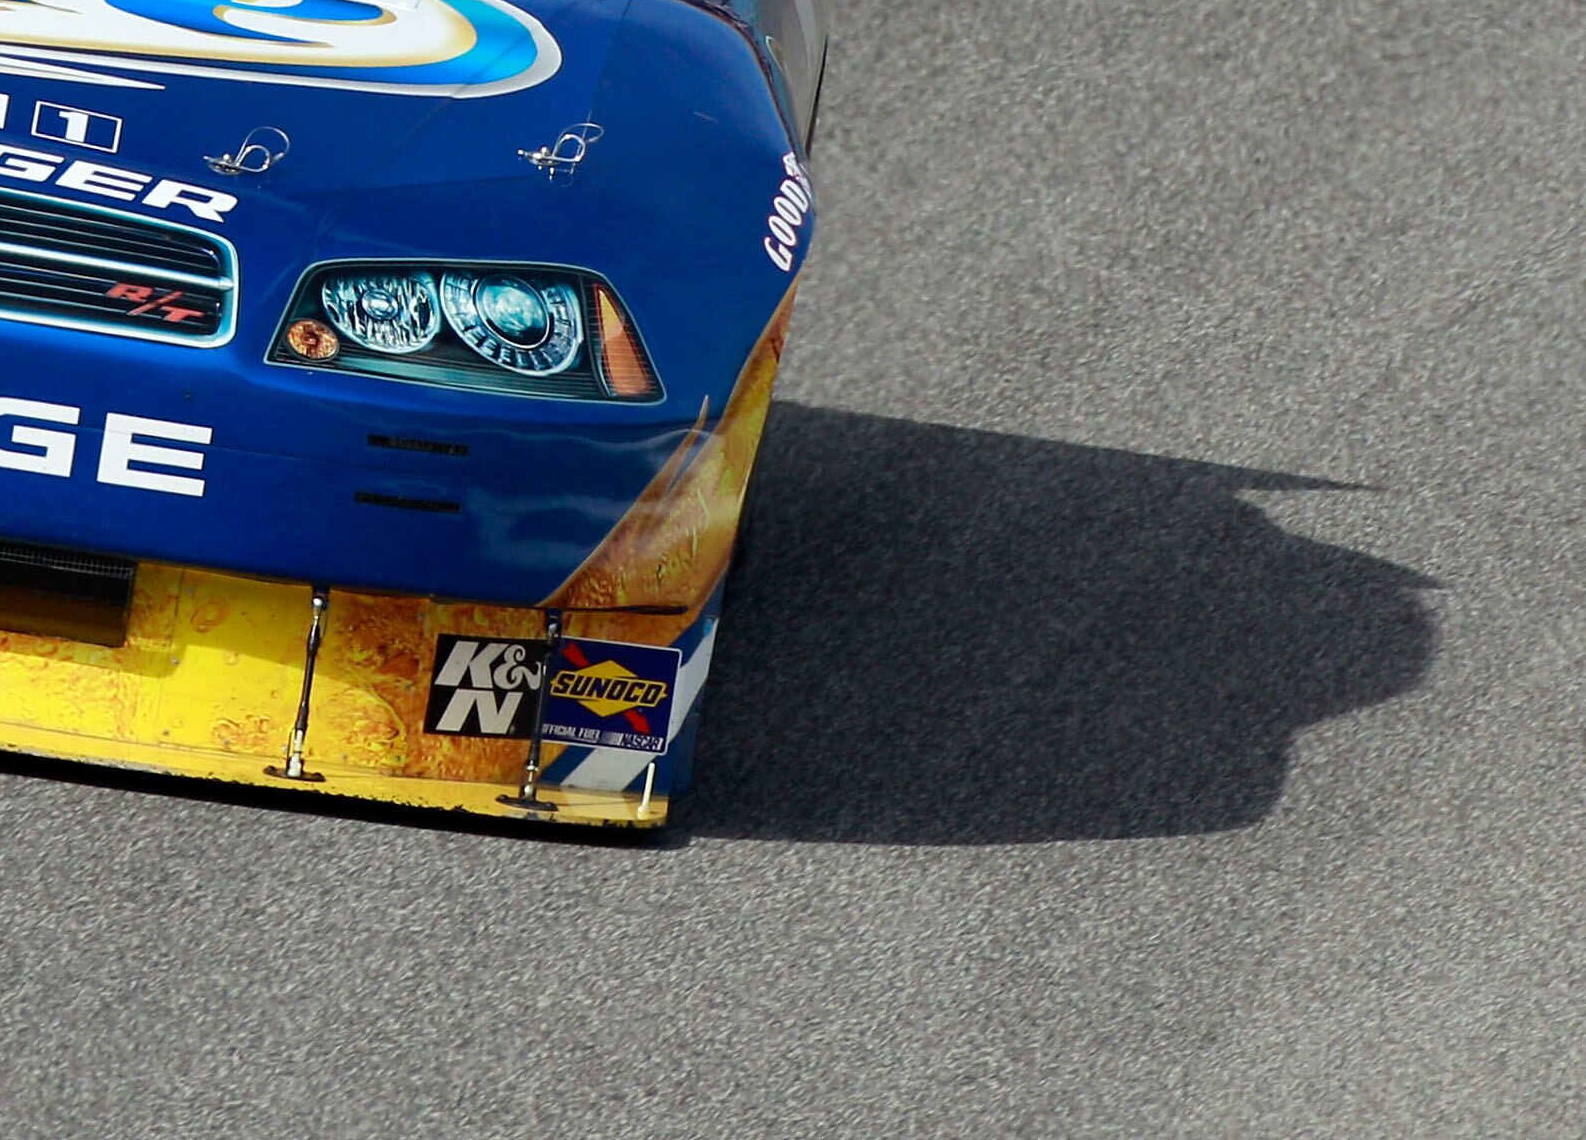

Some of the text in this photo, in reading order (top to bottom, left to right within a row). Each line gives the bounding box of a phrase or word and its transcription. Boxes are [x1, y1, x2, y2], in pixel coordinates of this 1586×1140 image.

[104, 282, 206, 323] R/T
[553, 673, 665, 705] SUNOCO
[578, 727, 601, 740] FUEL
